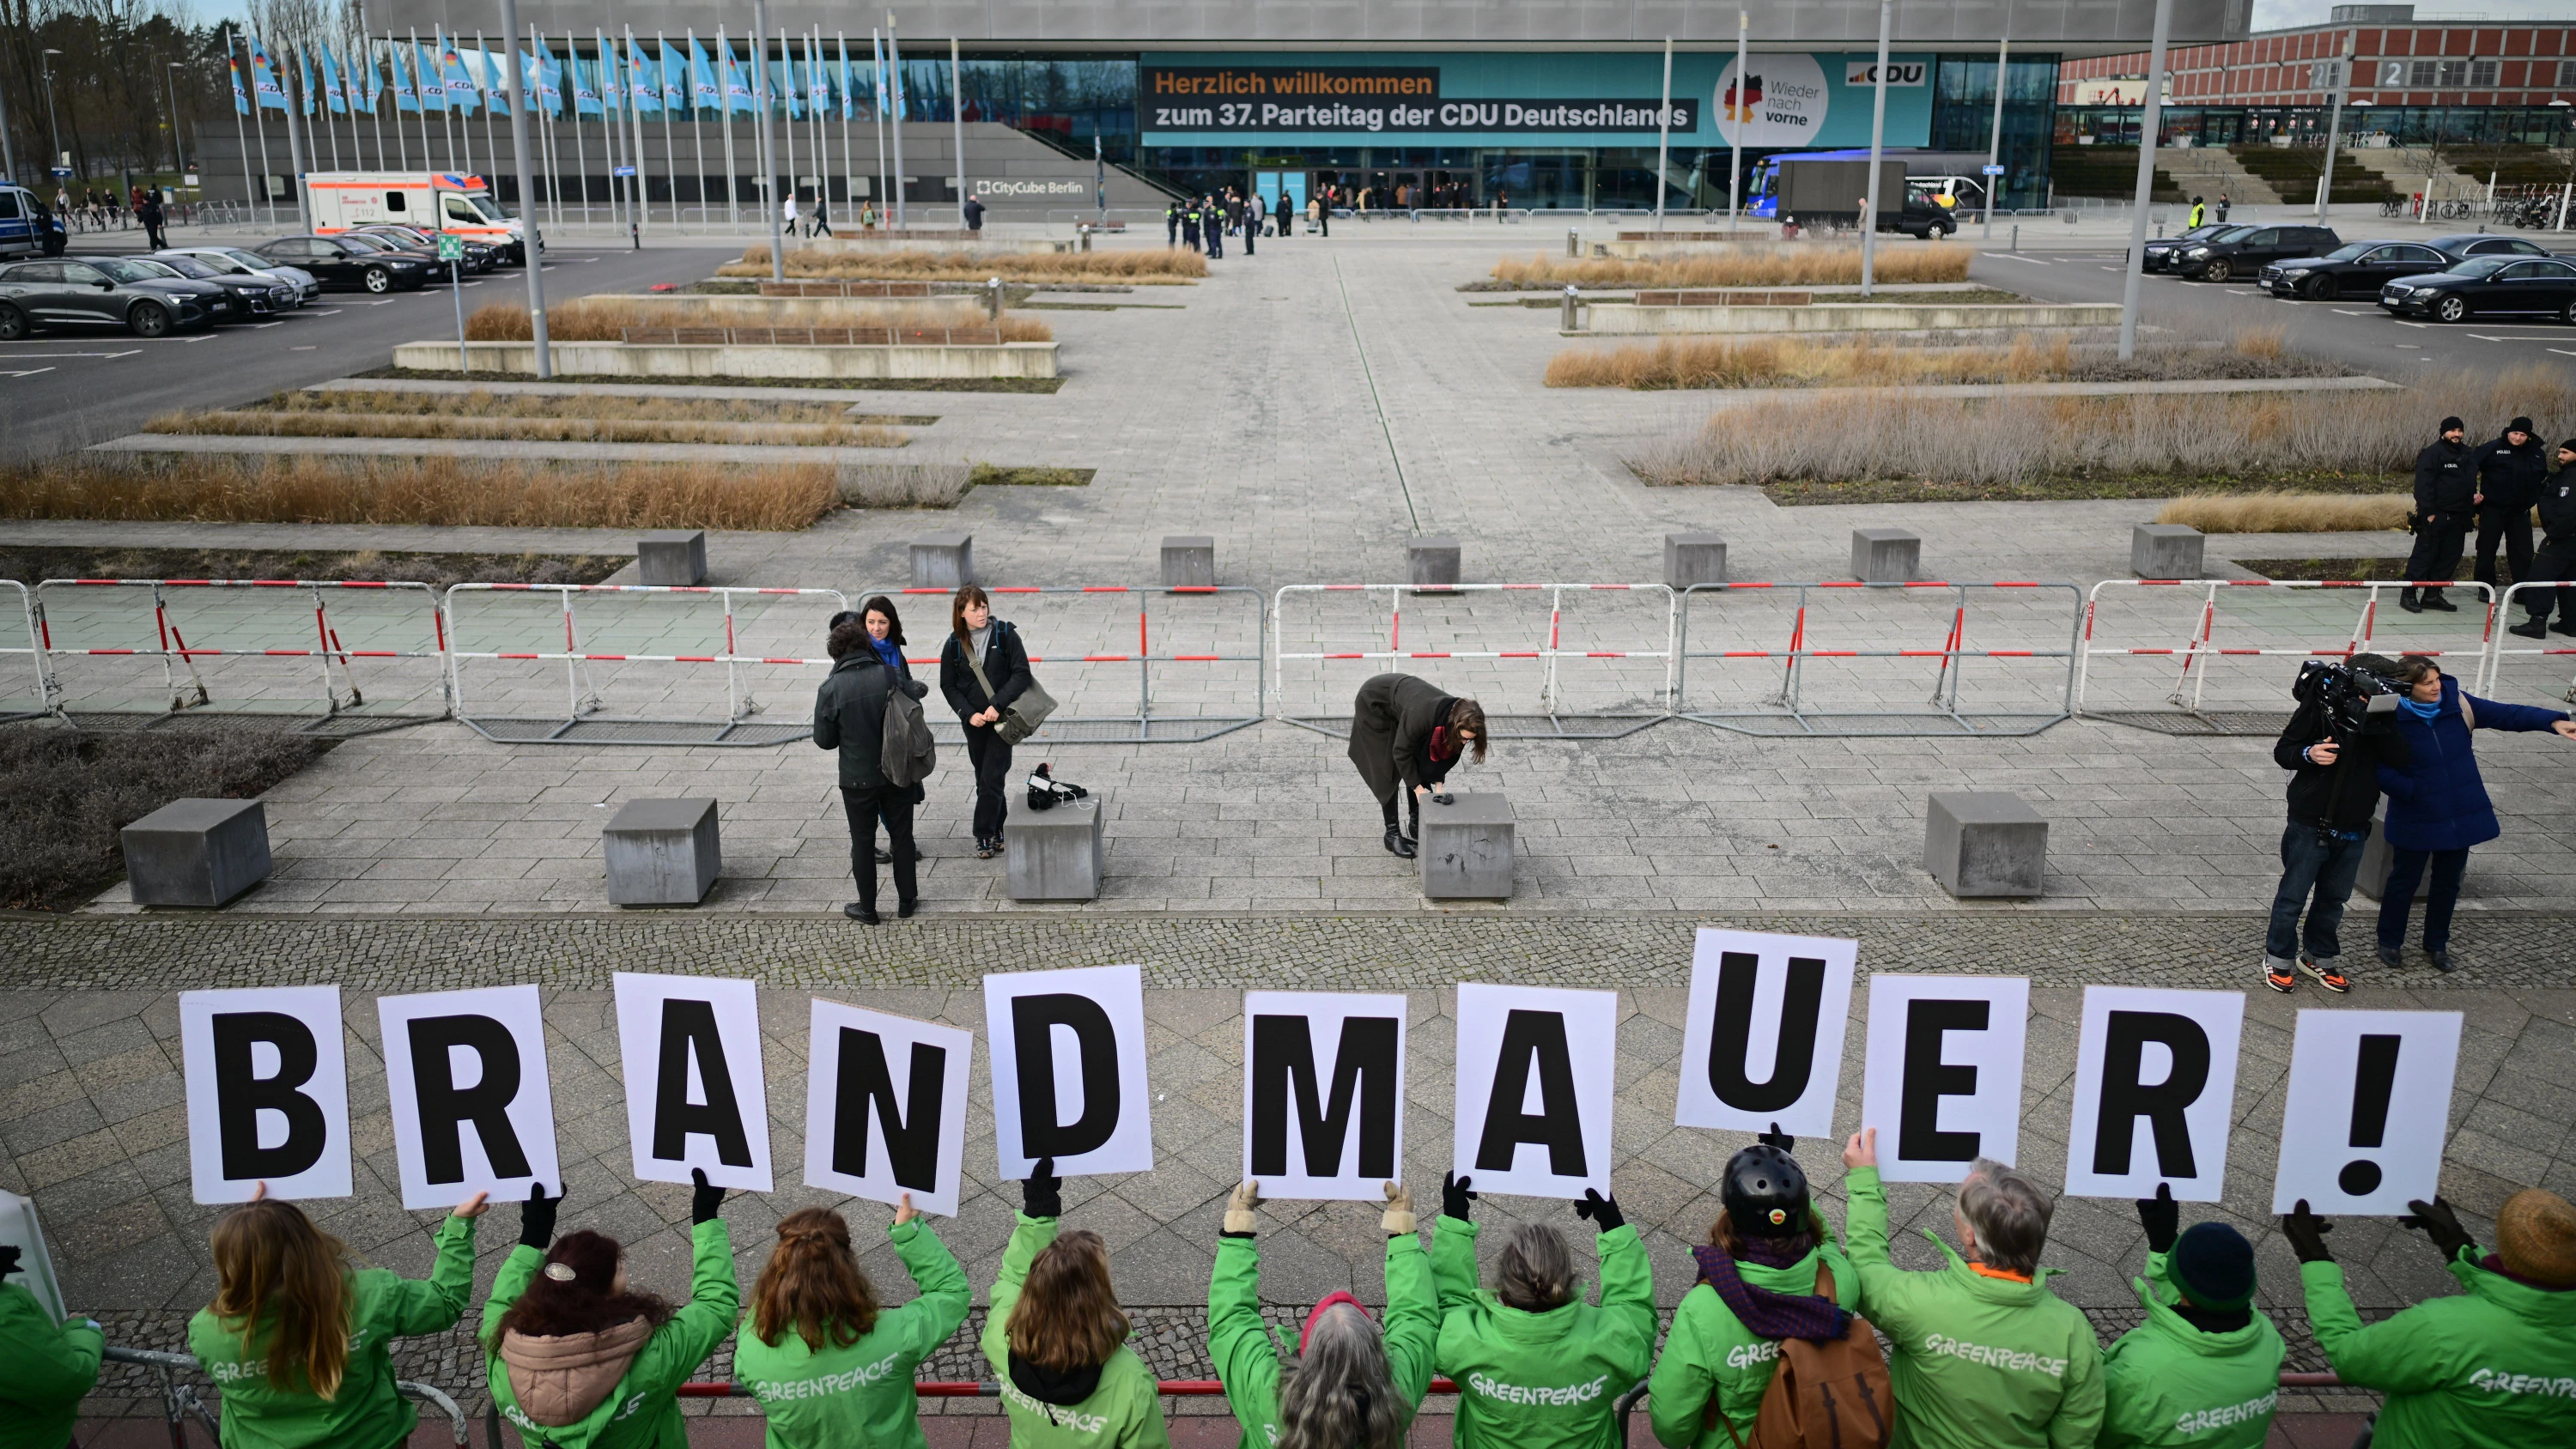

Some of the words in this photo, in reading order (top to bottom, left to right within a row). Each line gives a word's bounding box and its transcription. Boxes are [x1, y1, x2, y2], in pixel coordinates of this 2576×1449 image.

[1156, 71, 1266, 94] Herzlich
[1273, 71, 1432, 94] willkommen
[1867, 65, 1923, 82] CDU
[2315, 64, 2324, 85] 2
[2385, 62, 2401, 85] 2
[1771, 81, 1820, 99] Wieder
[1767, 95, 1801, 111] nach
[1156, 107, 1212, 125] zum
[1218, 104, 1256, 125] 37.
[1262, 102, 1382, 131] Parteitag
[1389, 104, 1434, 125] der
[1440, 104, 1498, 126] CDU
[1504, 104, 1688, 126] Deutschlands
[1765, 112, 1807, 125] vorne
[992, 181, 1046, 196] CityCube
[1048, 181, 1083, 193] Berlin
[1727, 1341, 1782, 1369] GREE
[1924, 1333, 2068, 1377] GREENPEACE
[756, 1352, 898, 1401] GREENPEACE
[1468, 1373, 1607, 1406] GREENPEACE
[2176, 1389, 2278, 1434] GREENPEA
